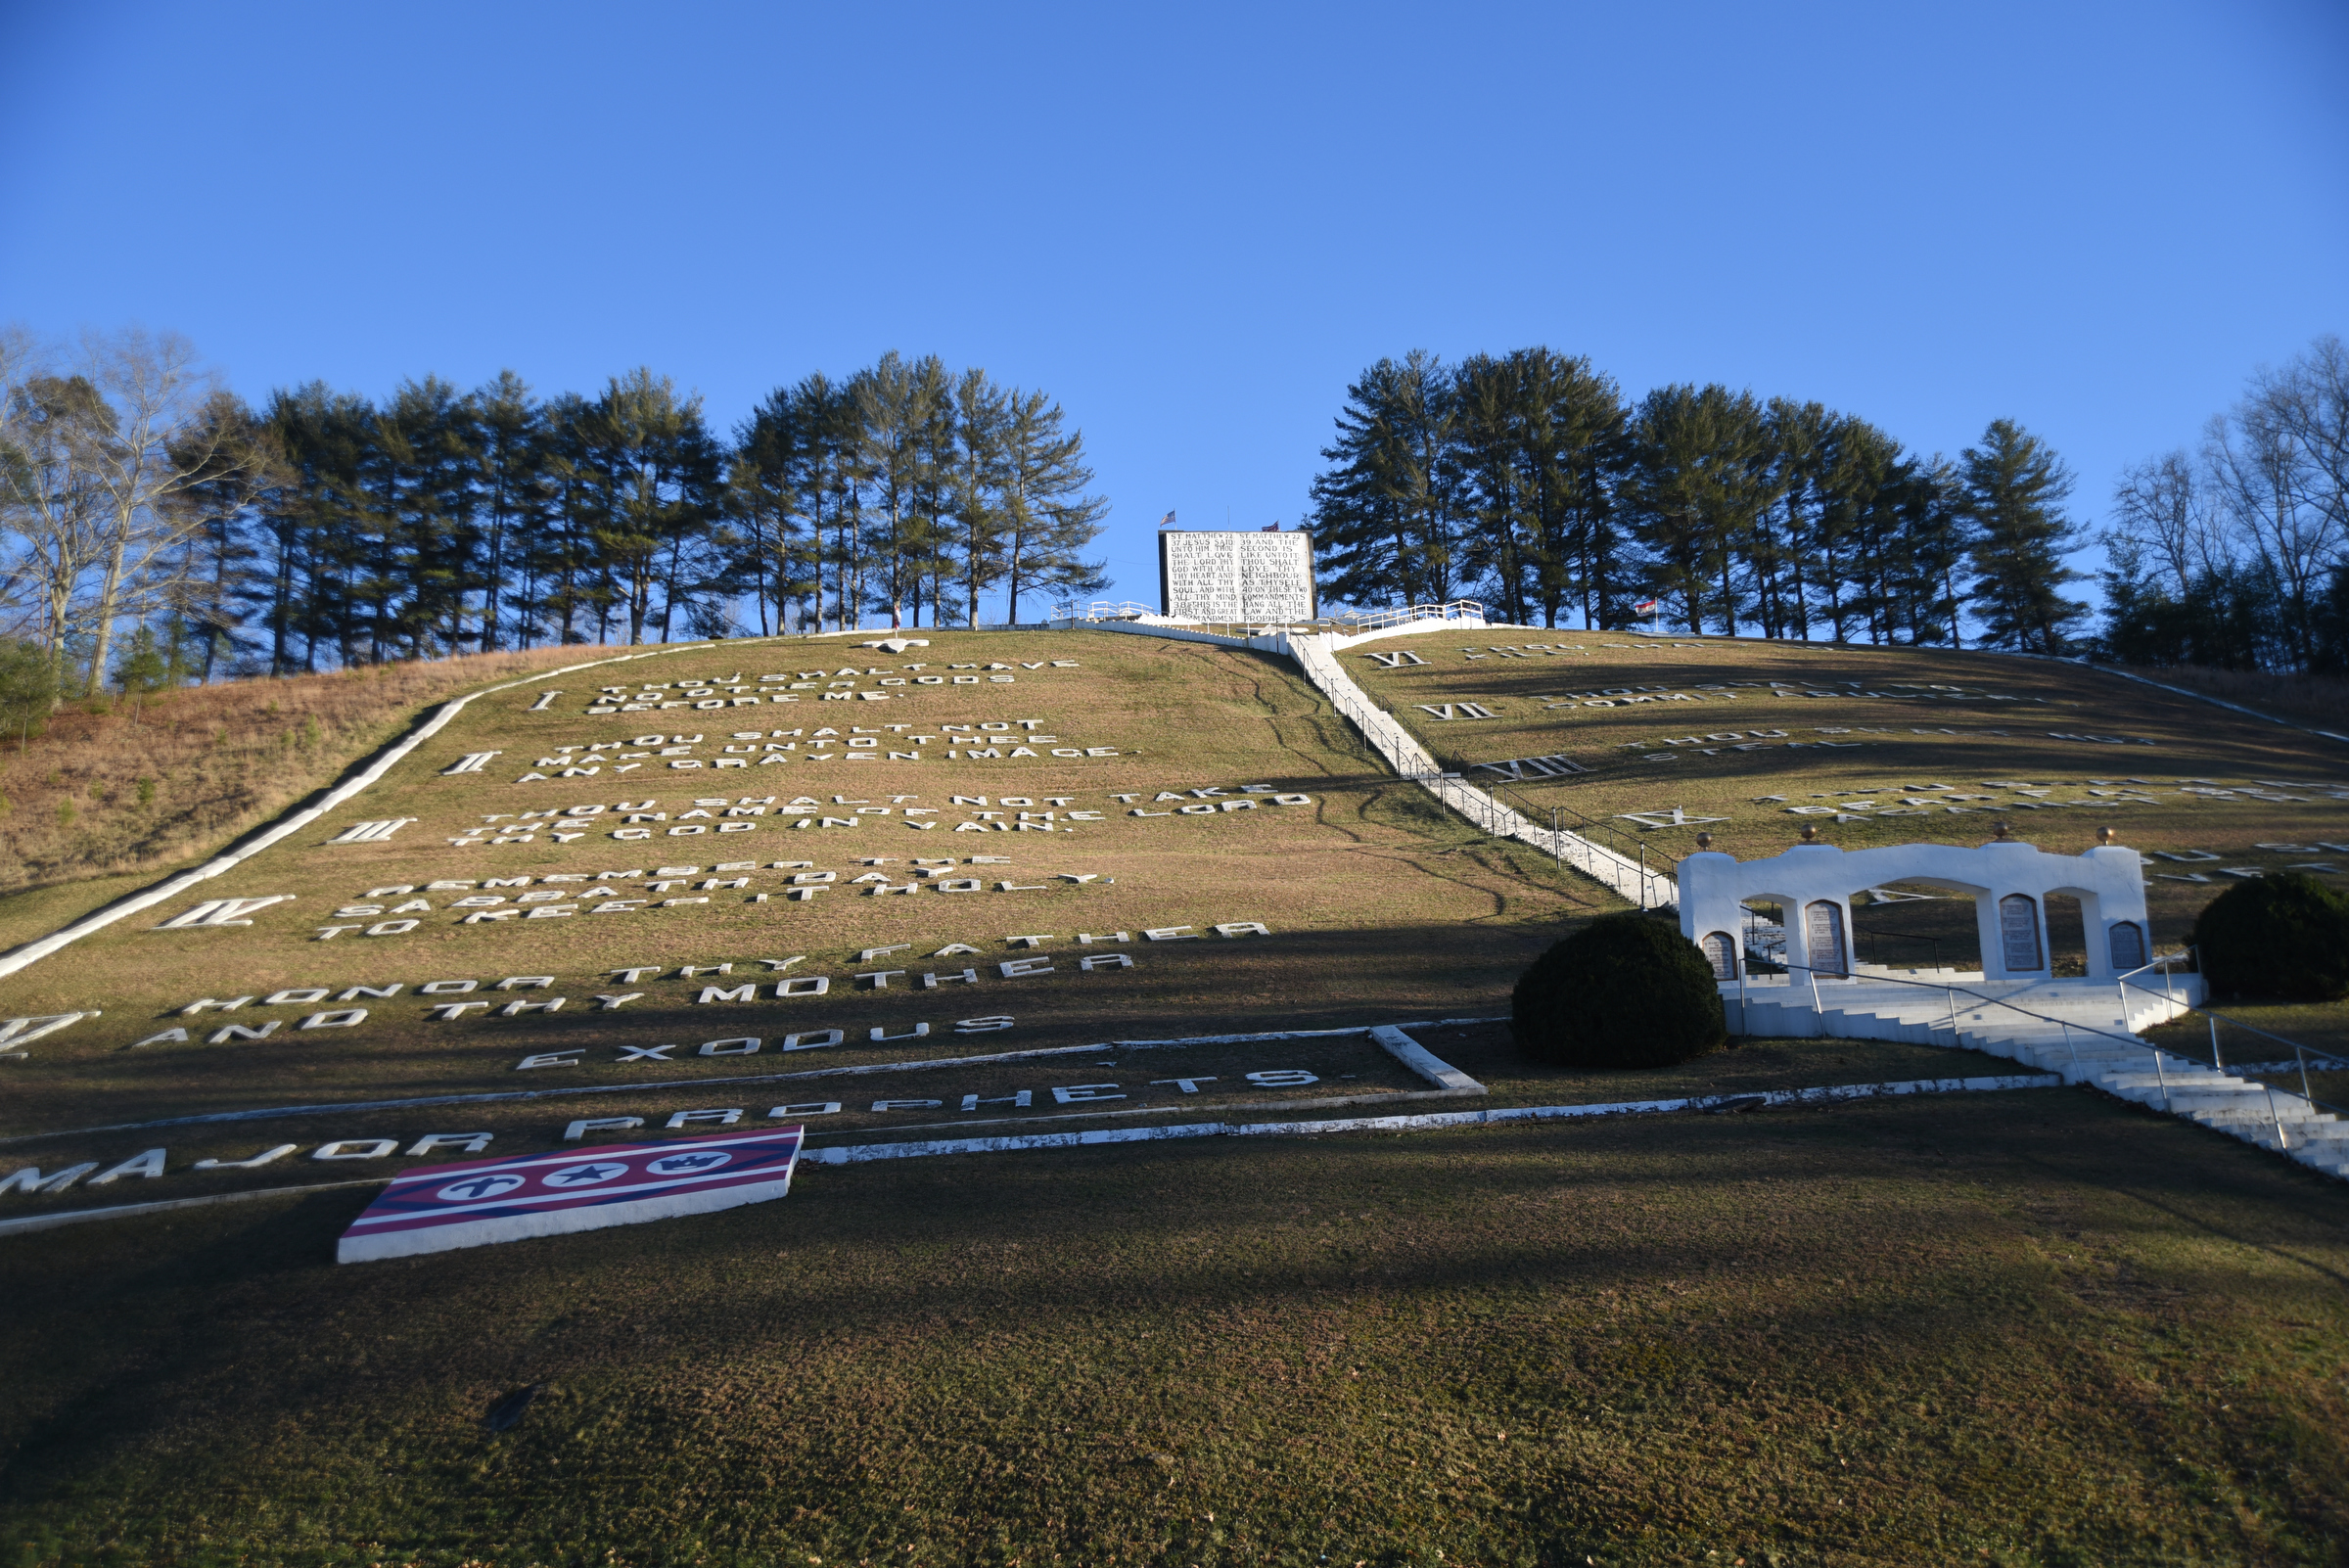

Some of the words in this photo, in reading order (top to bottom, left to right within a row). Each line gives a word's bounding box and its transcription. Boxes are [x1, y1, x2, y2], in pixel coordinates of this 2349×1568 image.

[1363, 650, 1433, 669] VI
[597, 692, 664, 705] NO
[686, 681, 855, 698] OTHER
[880, 674, 1015, 686] GODS
[602, 671, 741, 694] THOU
[758, 663, 927, 682] SHALT
[948, 659, 1080, 670] HAVE
[1529, 685, 1669, 702] THOU
[1694, 681, 1863, 692] SHALT
[587, 693, 800, 715] BEFORE
[1411, 702, 1503, 722] VII
[1546, 691, 1738, 710] COMMIT
[536, 745, 692, 767] MAKE
[724, 737, 878, 753] UNTO
[907, 735, 1058, 745] THEE
[554, 733, 704, 752] THOU
[731, 724, 912, 740] SHALT
[942, 718, 1044, 732] NOT
[1615, 729, 1789, 750] THOU
[441, 751, 502, 776] II
[517, 763, 642, 783] ANY
[670, 751, 919, 770] GRAVEN
[1470, 754, 1598, 784] VIII
[462, 817, 595, 836] THE
[628, 806, 818, 823] NAME
[856, 807, 940, 816] OF
[1133, 794, 1312, 817] LORD
[480, 799, 657, 823] THOU
[694, 795, 919, 807] SHALT
[952, 795, 1075, 807] NOT
[1108, 783, 1278, 804] TAKE
[1786, 794, 1998, 814] BEAR
[326, 816, 418, 846] III
[447, 832, 585, 847] THY
[613, 822, 757, 840] GOD
[796, 816, 858, 829] IN
[333, 877, 750, 918] SABBATH
[793, 866, 954, 885] DAY
[365, 860, 813, 898] REMEMBER
[859, 855, 1011, 866] THE
[148, 894, 297, 931] IV
[316, 919, 420, 941] TO
[465, 896, 710, 924] KEEP
[756, 885, 830, 902] IT
[181, 976, 555, 1016] HONOR
[610, 955, 807, 984] THY
[861, 921, 1270, 961] FATHER
[131, 1008, 369, 1048] AND
[434, 992, 646, 1021] THY
[699, 953, 1135, 1003] MOTHER
[515, 1015, 1016, 1071] EXODUS
[0, 1131, 494, 1194] MAJOR
[564, 1069, 1320, 1140] PROPHETS
